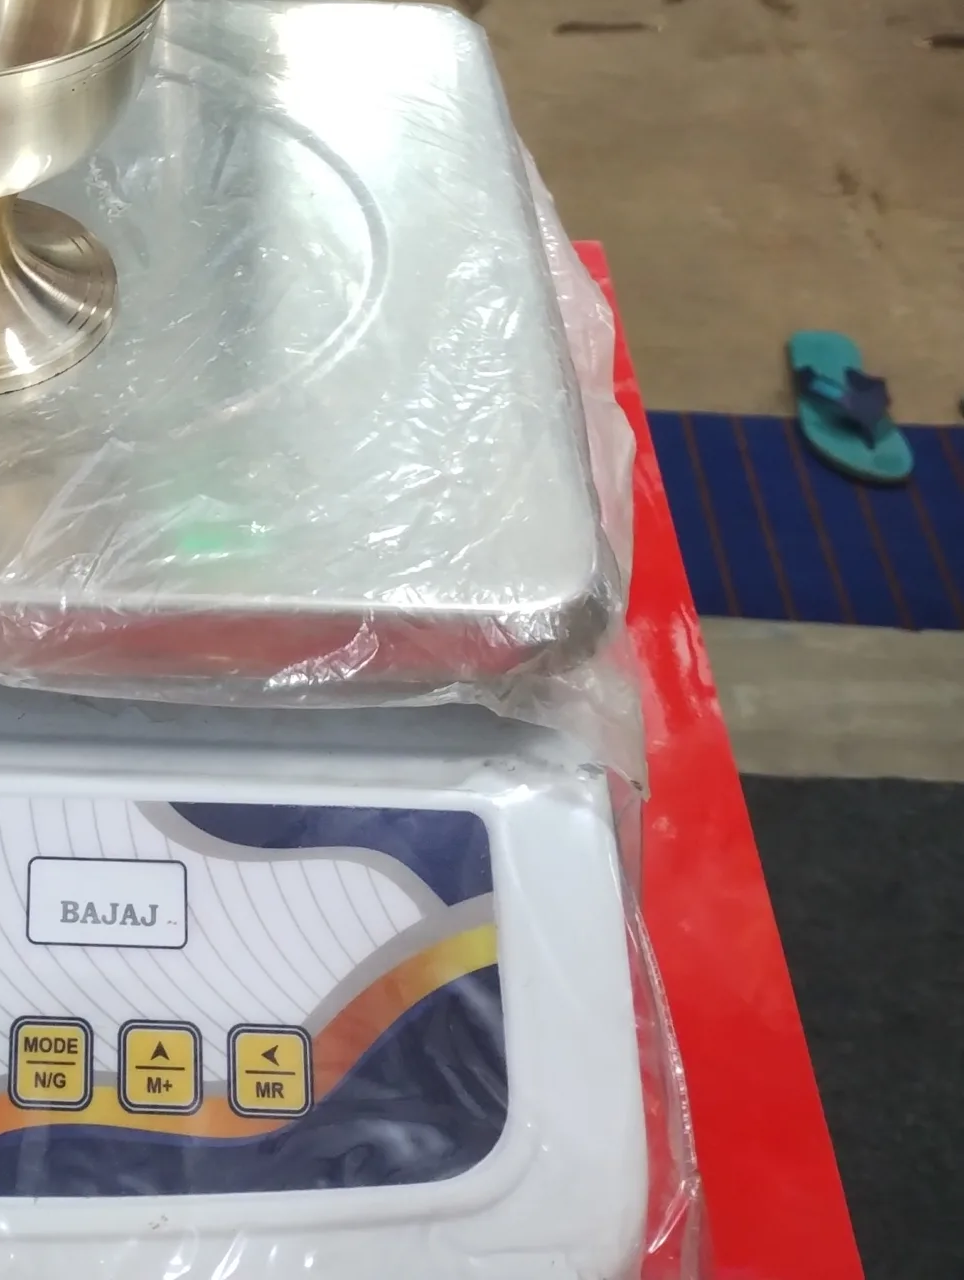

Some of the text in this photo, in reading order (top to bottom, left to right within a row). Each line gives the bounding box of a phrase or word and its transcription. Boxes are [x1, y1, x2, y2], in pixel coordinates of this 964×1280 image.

[60, 900, 159, 927] BAJAJ
[23, 1036, 79, 1054] MODE
[34, 1071, 67, 1089] N/G
[147, 1079, 172, 1094] M+
[255, 1082, 284, 1100] MR
